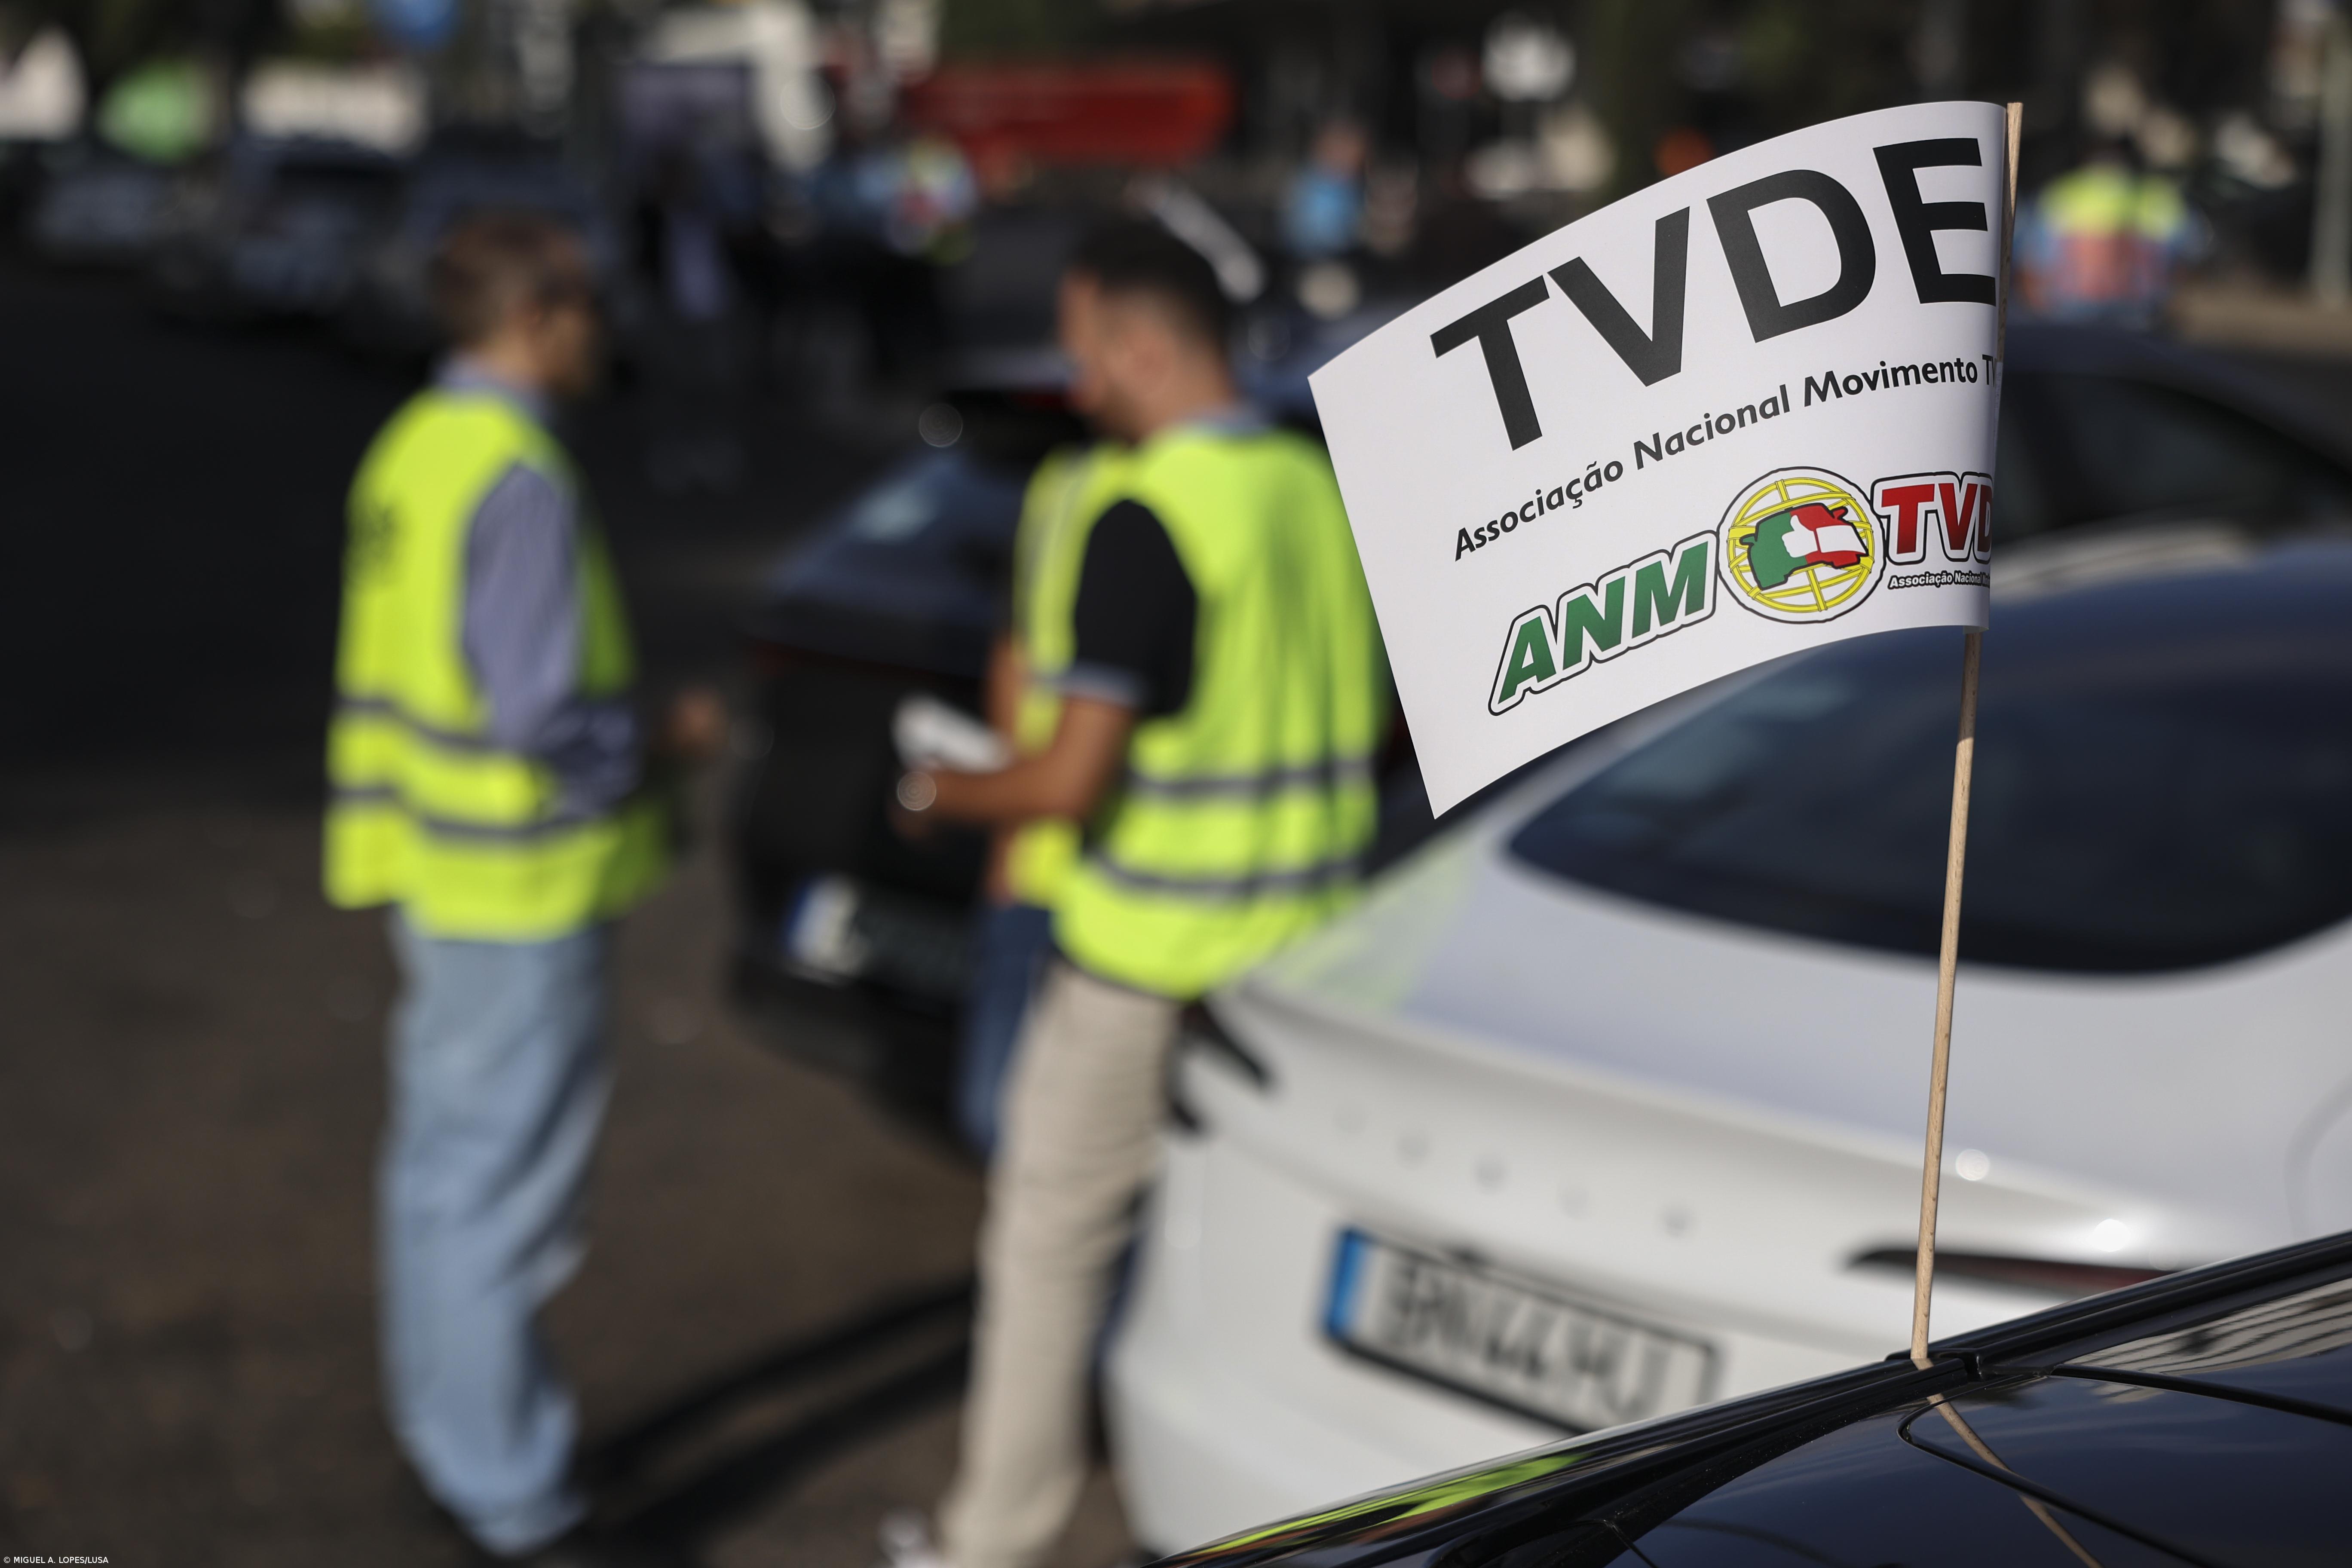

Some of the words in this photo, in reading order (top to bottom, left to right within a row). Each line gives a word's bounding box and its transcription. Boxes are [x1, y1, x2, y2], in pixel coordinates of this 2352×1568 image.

[1430, 138, 1996, 450] TVDE
[1455, 461, 1623, 561] Associação
[1633, 384, 1790, 470] Nacional
[1804, 358, 1977, 407] Movimento
[1498, 541, 1708, 705] ANM
[1889, 572, 1953, 588] Associação
[1955, 572, 1981, 585] Nacional
